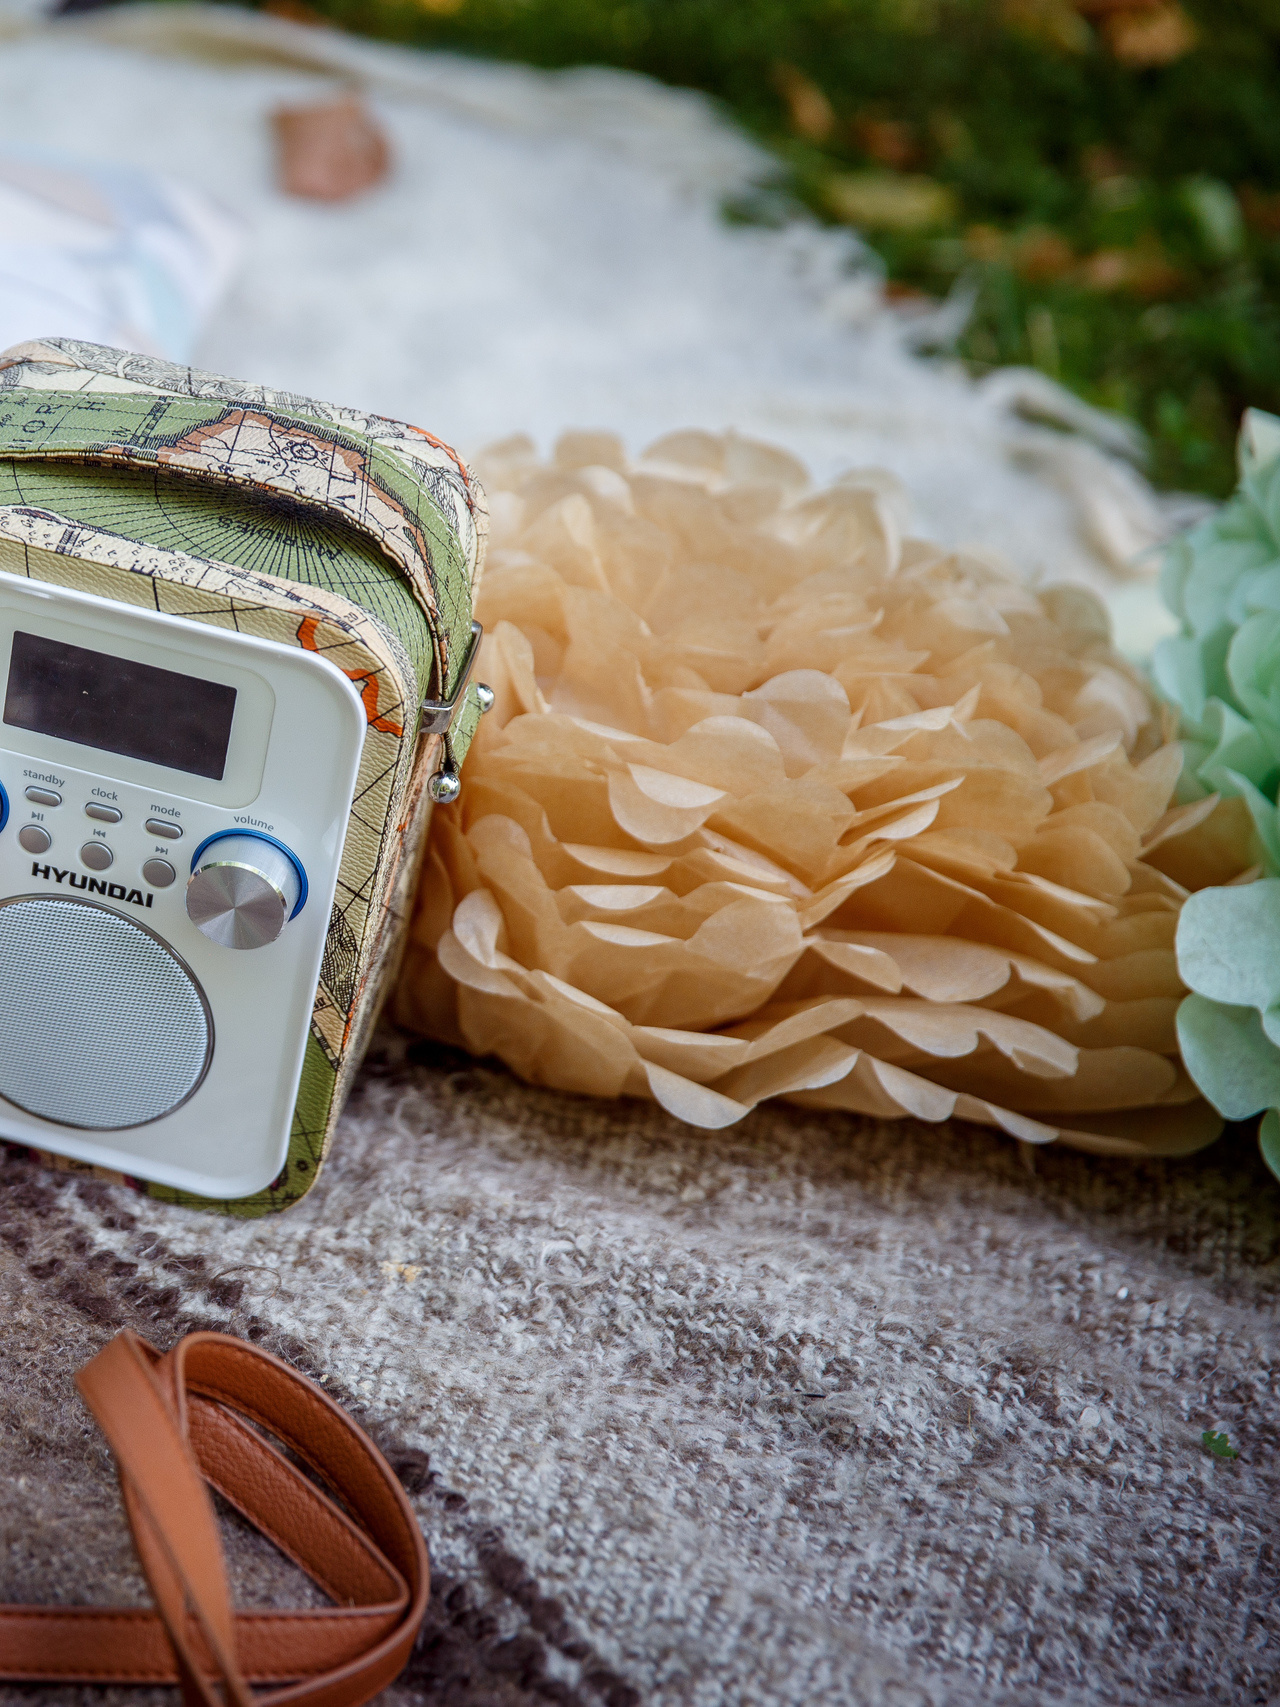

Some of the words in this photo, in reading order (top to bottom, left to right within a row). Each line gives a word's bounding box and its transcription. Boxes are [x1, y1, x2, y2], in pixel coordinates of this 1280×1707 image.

[23, 768, 65, 787] standby
[91, 786, 118, 801] clock
[150, 803, 181, 818] mode
[233, 815, 275, 832] volume
[32, 862, 154, 908] HYUNDAI
